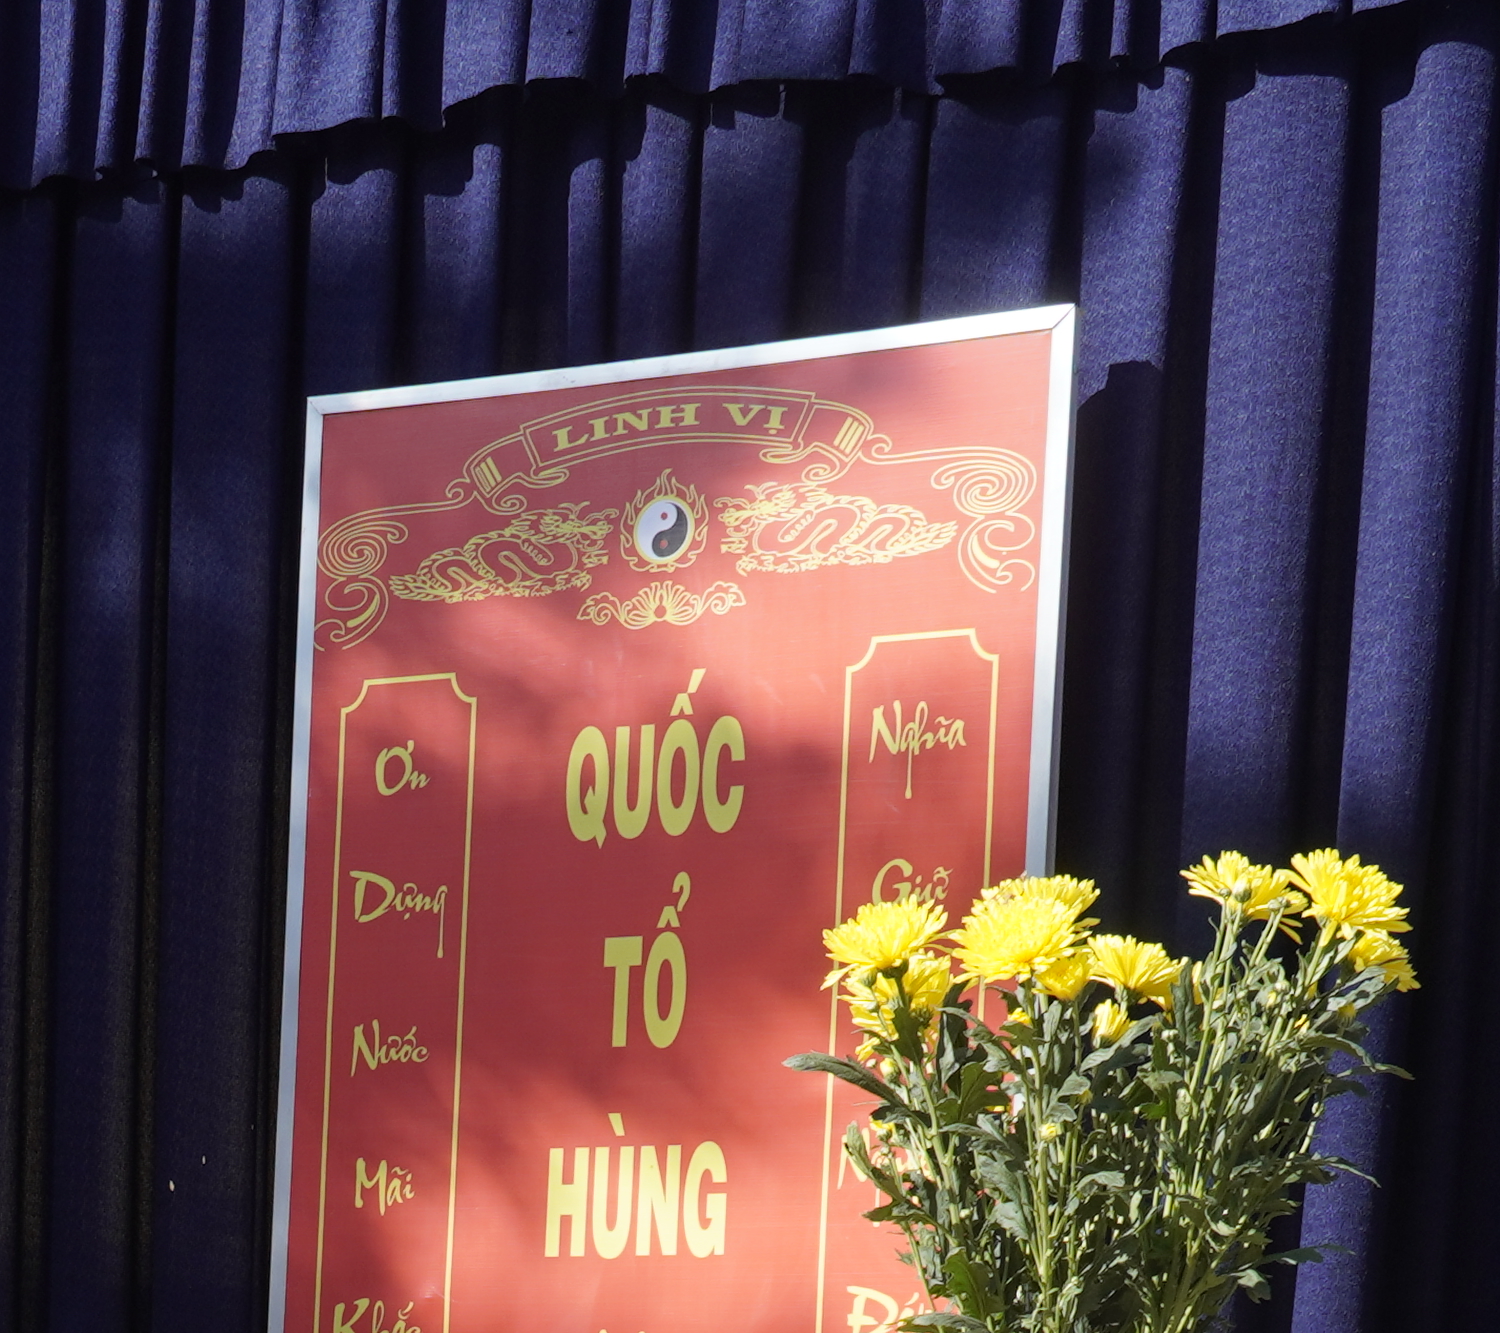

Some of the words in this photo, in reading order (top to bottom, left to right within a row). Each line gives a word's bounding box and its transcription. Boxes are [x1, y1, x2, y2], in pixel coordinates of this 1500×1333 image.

[551, 402, 700, 452] LINH
[722, 402, 790, 435] VỊ
[375, 739, 431, 796] Ơn
[565, 667, 747, 848] QUỐC
[869, 700, 967, 800] Nghĩa
[349, 870, 448, 959] Dựng
[871, 858, 953, 906] Giữ
[603, 871, 690, 1049] TỔ
[351, 1019, 430, 1078] Nước
[354, 1155, 416, 1217] Mãi
[543, 1112, 729, 1260] HÙNG
